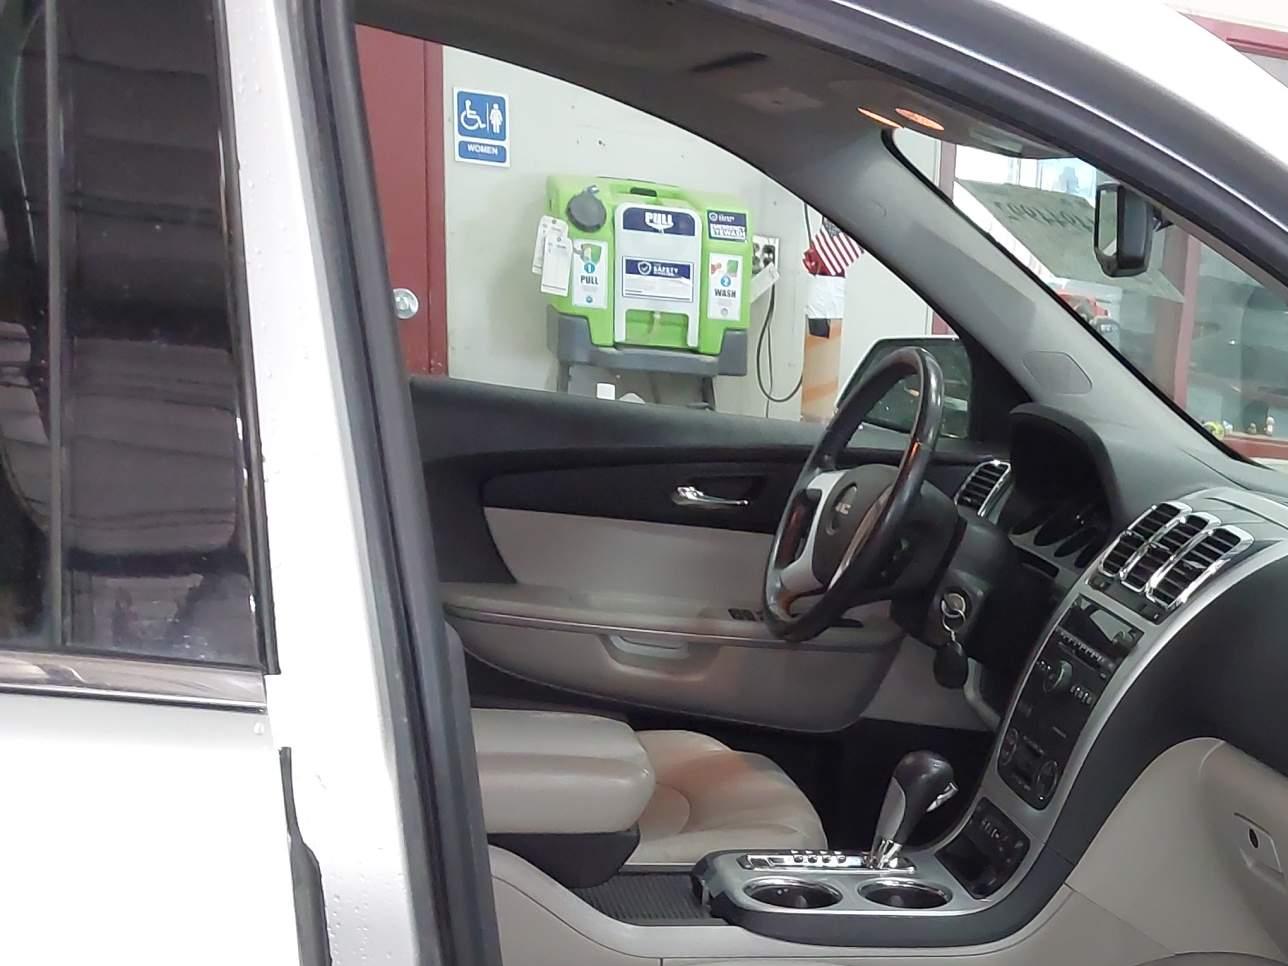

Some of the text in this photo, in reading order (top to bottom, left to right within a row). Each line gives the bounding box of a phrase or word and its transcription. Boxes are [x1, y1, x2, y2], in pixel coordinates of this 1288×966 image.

[467, 143, 498, 155] WOMEN
[644, 211, 674, 226] PULL
[580, 275, 599, 285] PULL
[714, 288, 737, 298] WASH
